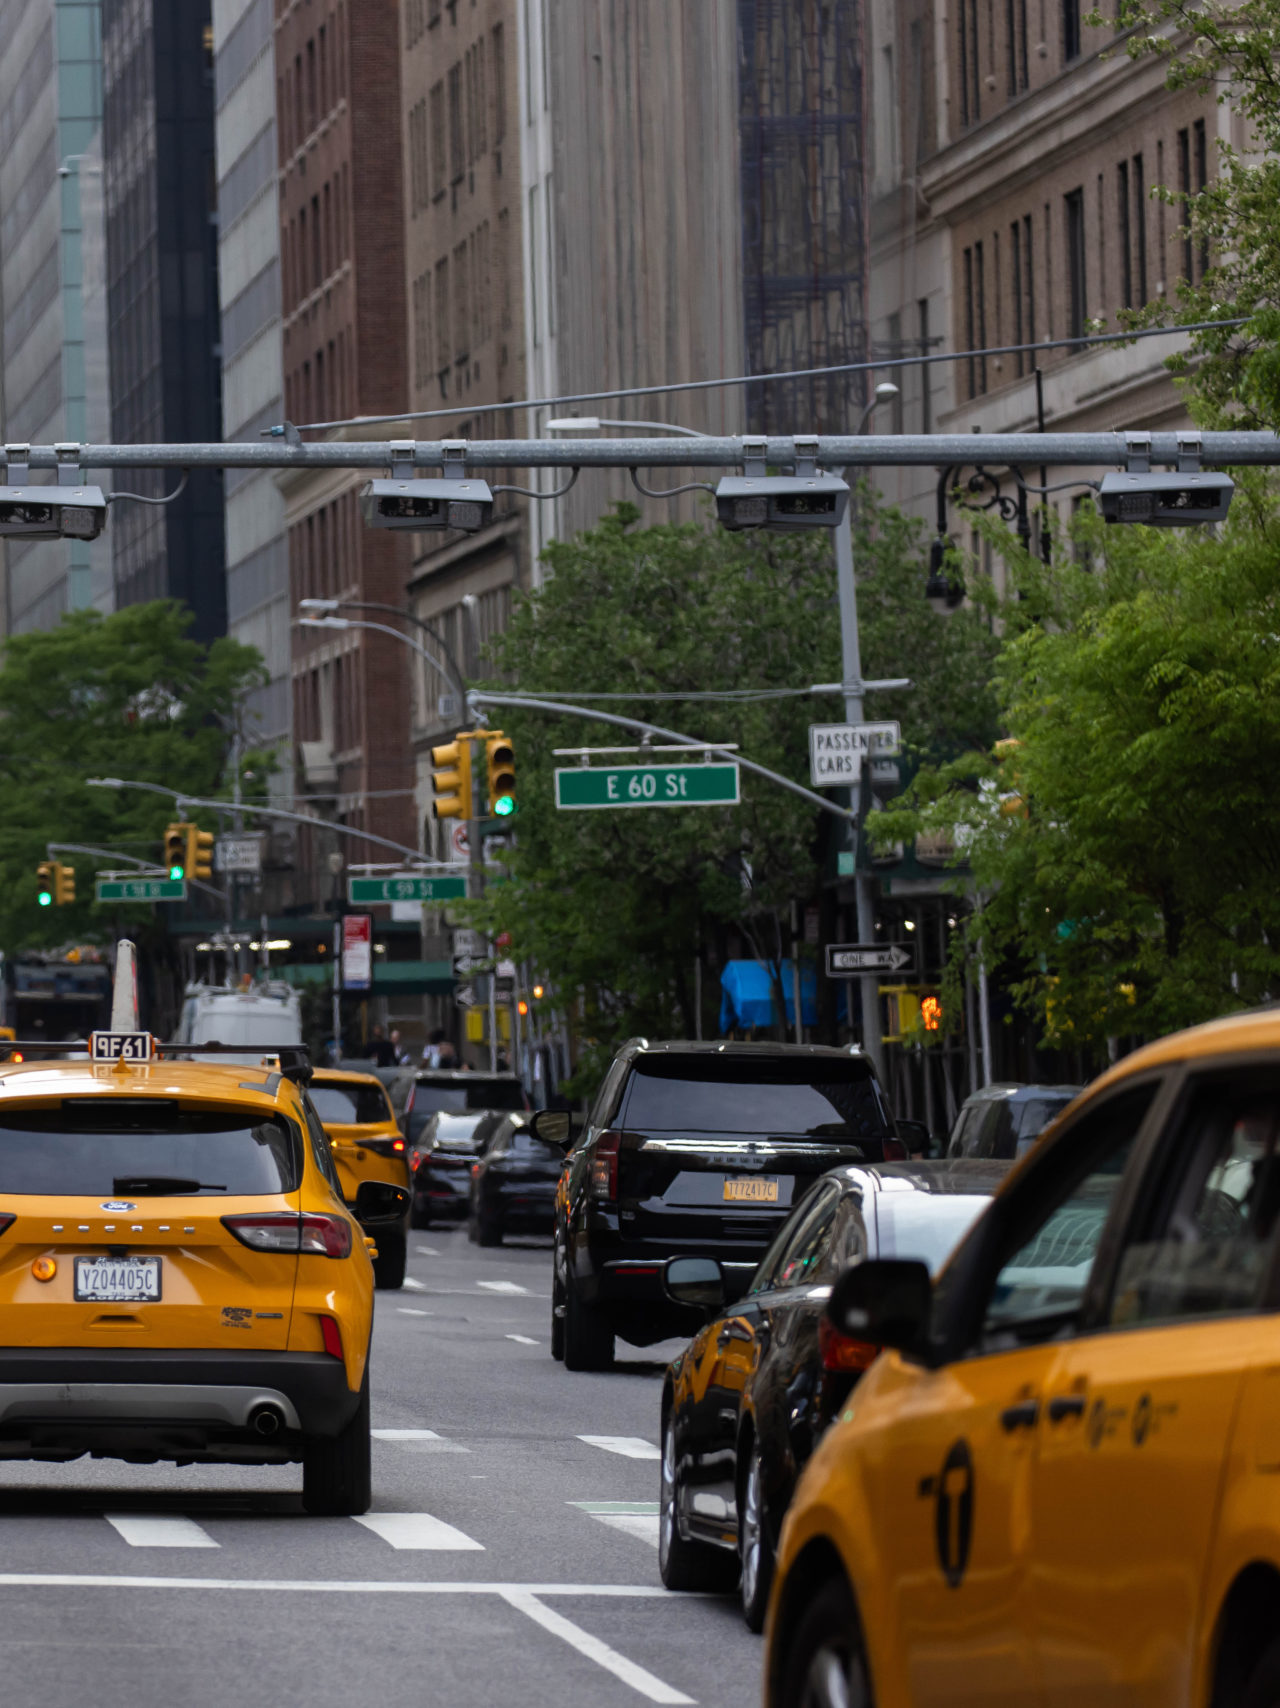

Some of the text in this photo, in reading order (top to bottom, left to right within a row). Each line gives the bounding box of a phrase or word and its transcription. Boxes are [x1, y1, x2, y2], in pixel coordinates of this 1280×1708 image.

[817, 730, 895, 750] PASSENER
[817, 755, 852, 773] CARS
[607, 773, 688, 799] E 60 St
[98, 1037, 143, 1057] 9F61
[729, 1182, 773, 1197] T772417C
[108, 1201, 129, 1209] Ford
[52, 1225, 195, 1234] ESCAPE
[83, 1269, 153, 1290] Y204405C
